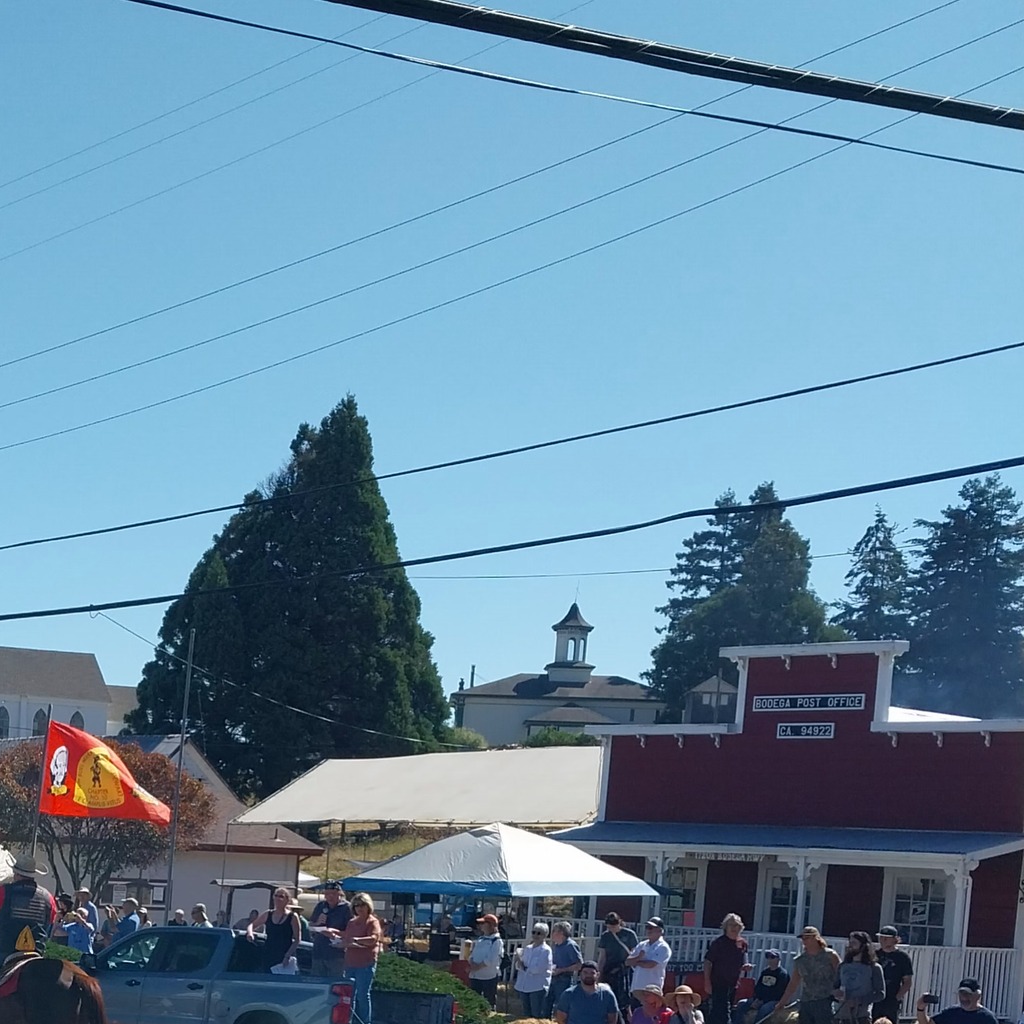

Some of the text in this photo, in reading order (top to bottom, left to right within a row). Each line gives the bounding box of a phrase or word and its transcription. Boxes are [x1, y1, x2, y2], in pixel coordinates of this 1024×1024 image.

[755, 696, 862, 709] BODEGA POST OFFICE
[779, 726, 832, 736] CA. 94922
